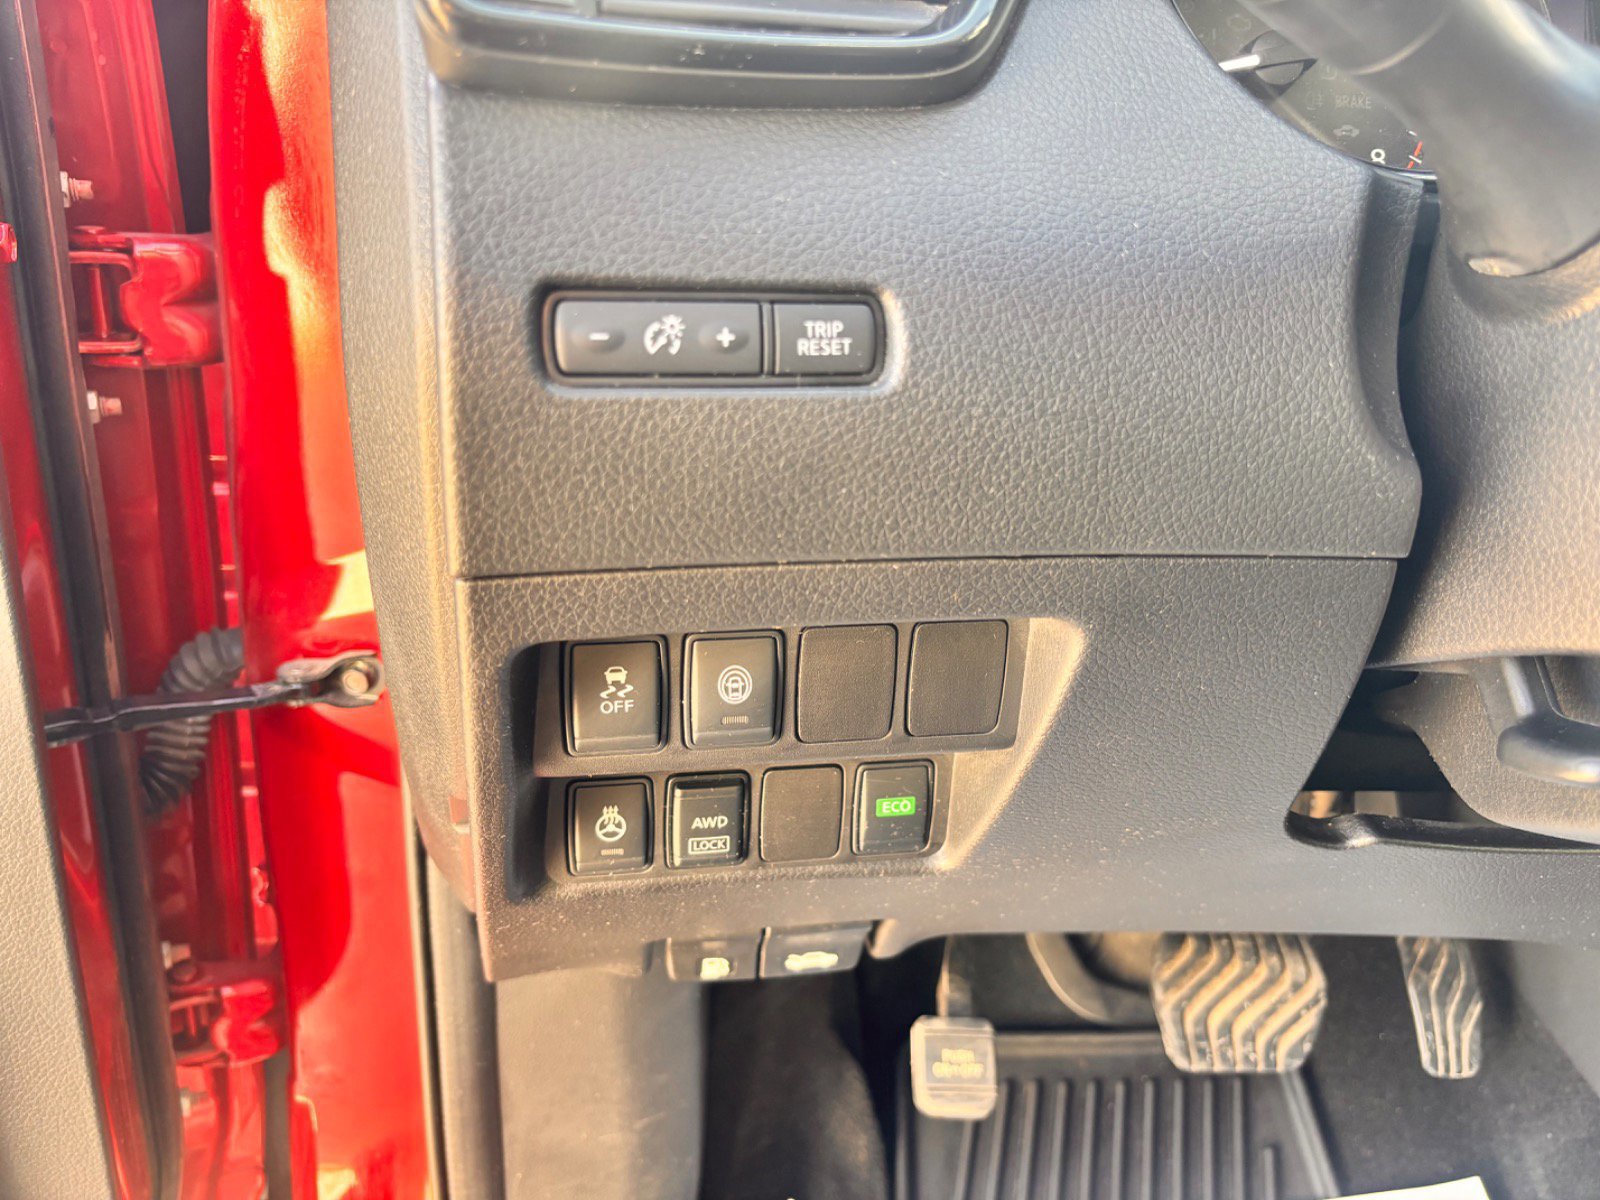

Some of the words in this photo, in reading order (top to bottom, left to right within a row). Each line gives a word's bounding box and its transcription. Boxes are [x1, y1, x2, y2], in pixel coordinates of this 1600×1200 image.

[1335, 94, 1372, 109] BRAKE
[803, 320, 844, 338] TRIP
[797, 337, 853, 356] RESET
[600, 699, 634, 714] OFF
[881, 799, 912, 814] ECO
[691, 815, 728, 830] AWD
[692, 838, 726, 851] LOCK
